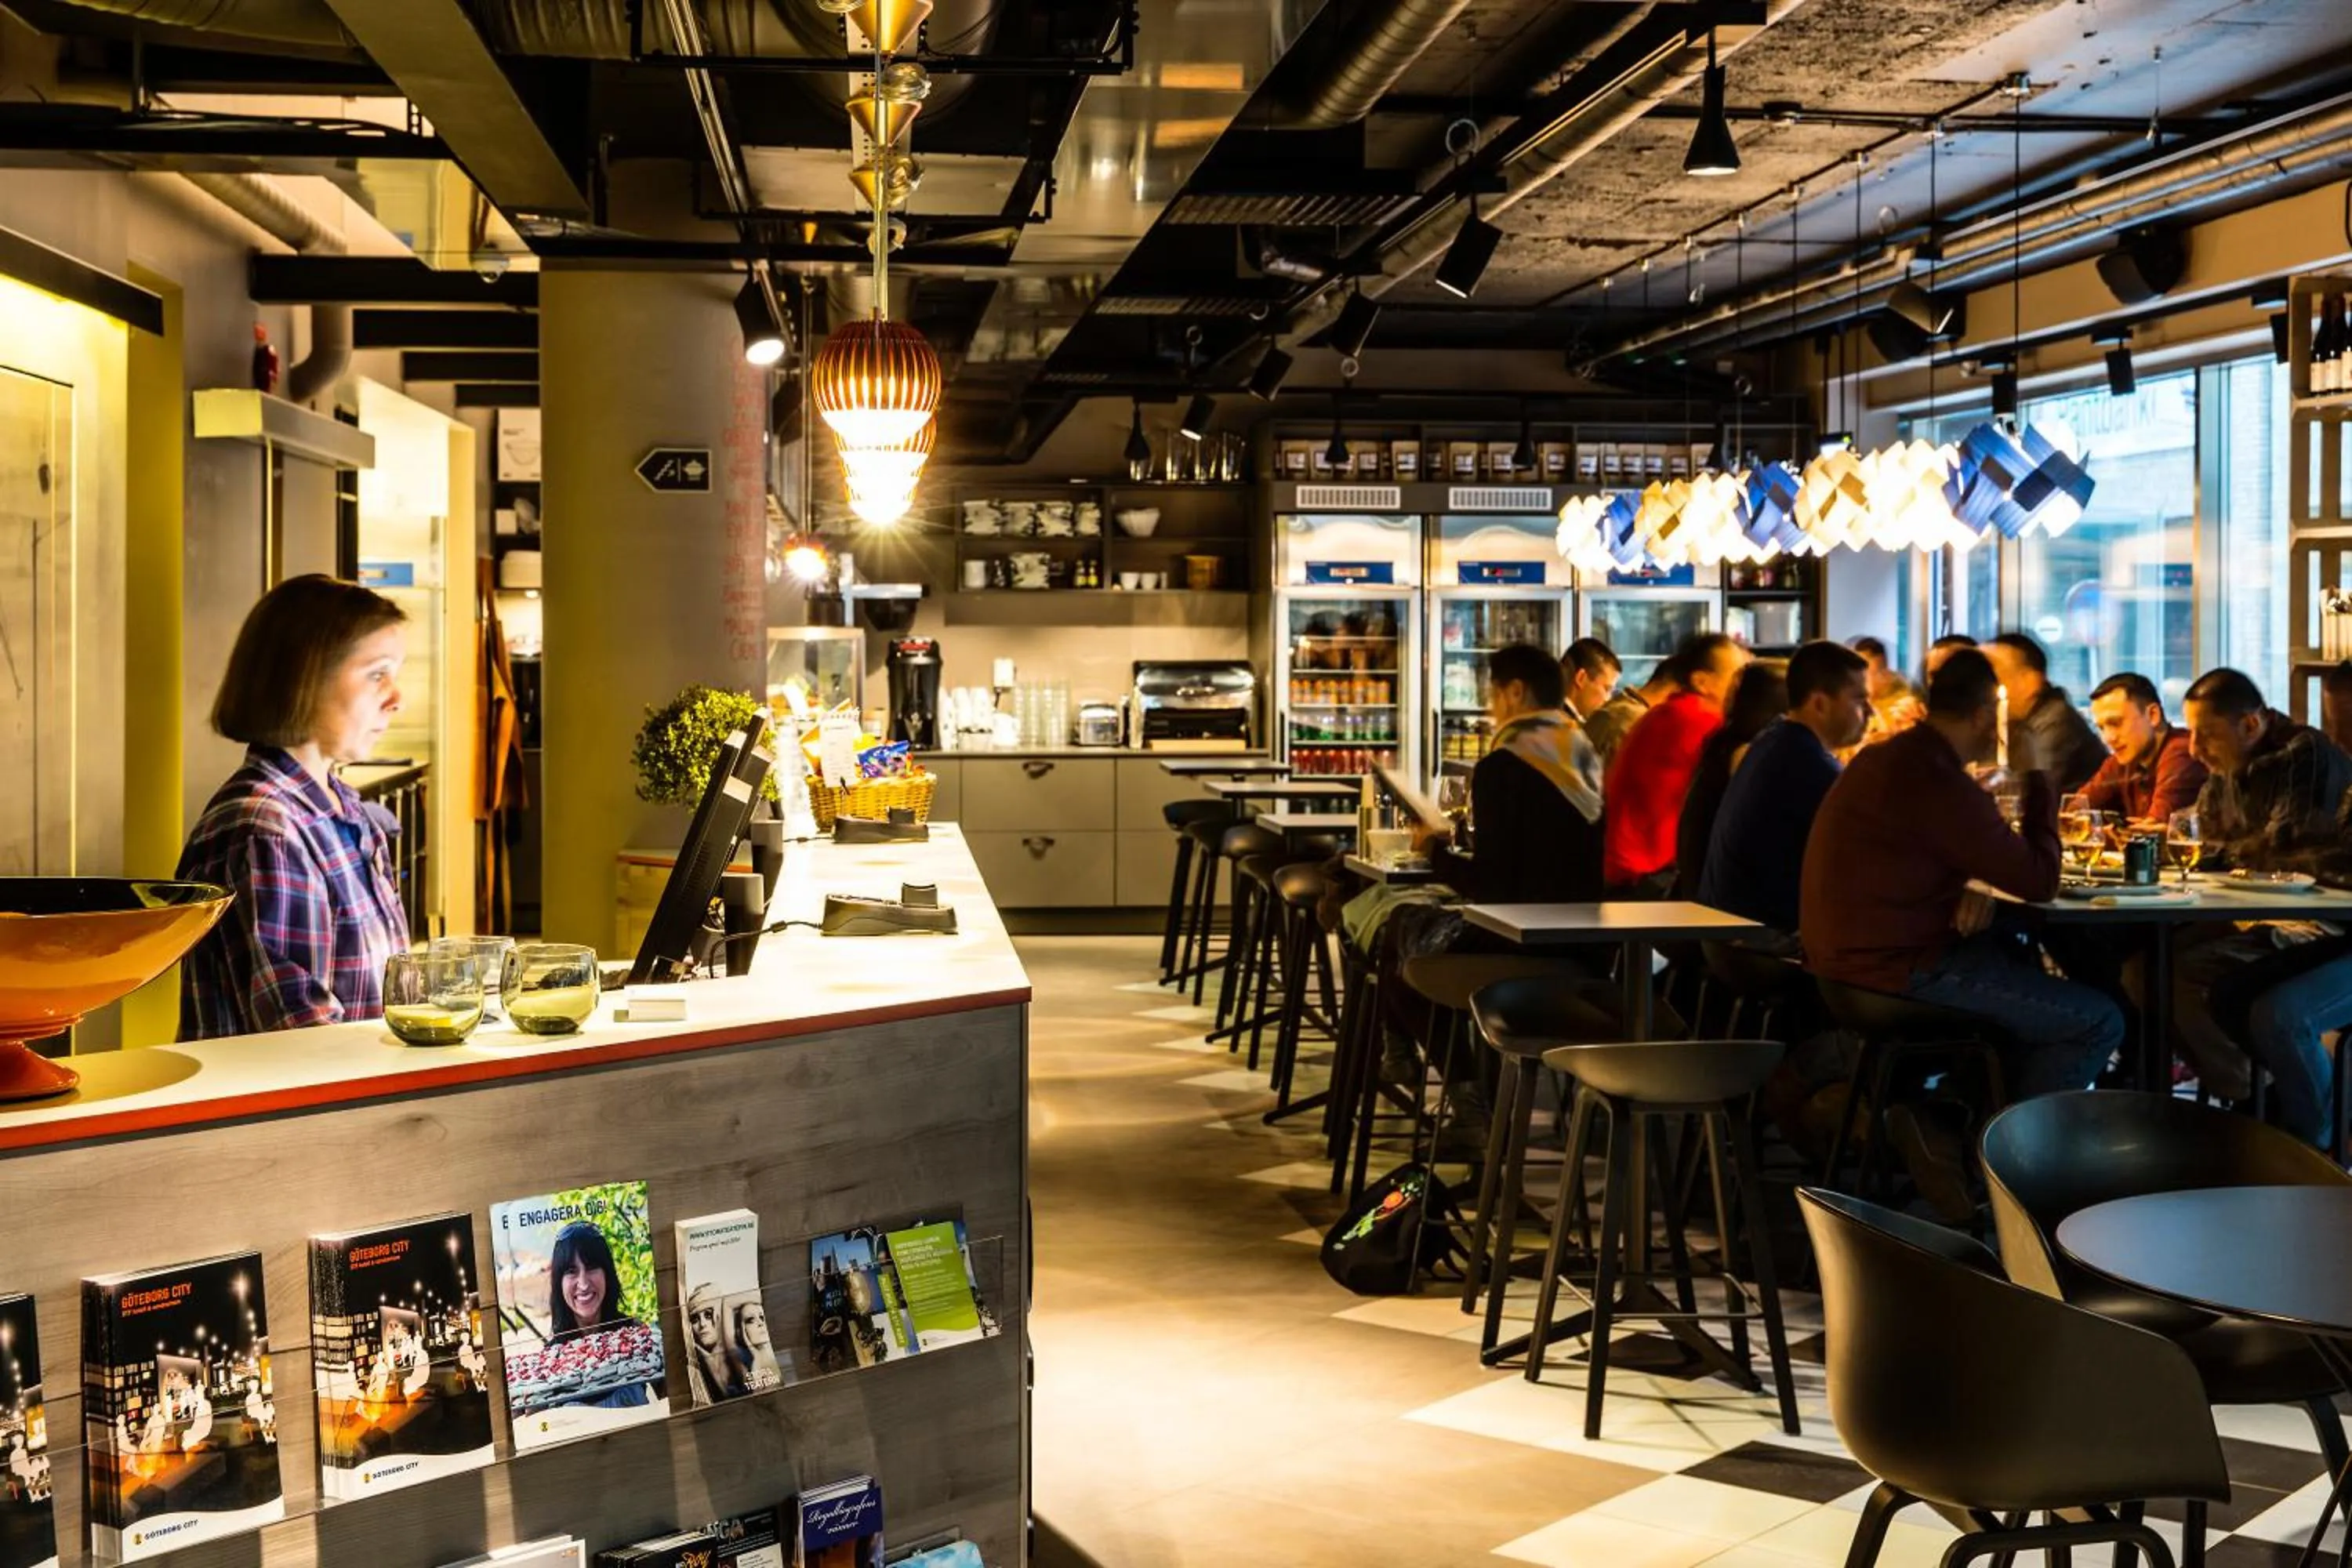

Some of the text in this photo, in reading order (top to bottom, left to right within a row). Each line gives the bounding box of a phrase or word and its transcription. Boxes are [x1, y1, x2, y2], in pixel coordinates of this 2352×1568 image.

[519, 1200, 608, 1227] ENGAGERA DIG!
[349, 1244, 390, 1262] GÖTEBORG
[392, 1240, 410, 1254] CITY
[122, 1287, 170, 1308] GÖTEBORG
[172, 1282, 192, 1298] CITY
[183, 1519, 198, 1530] CITY
